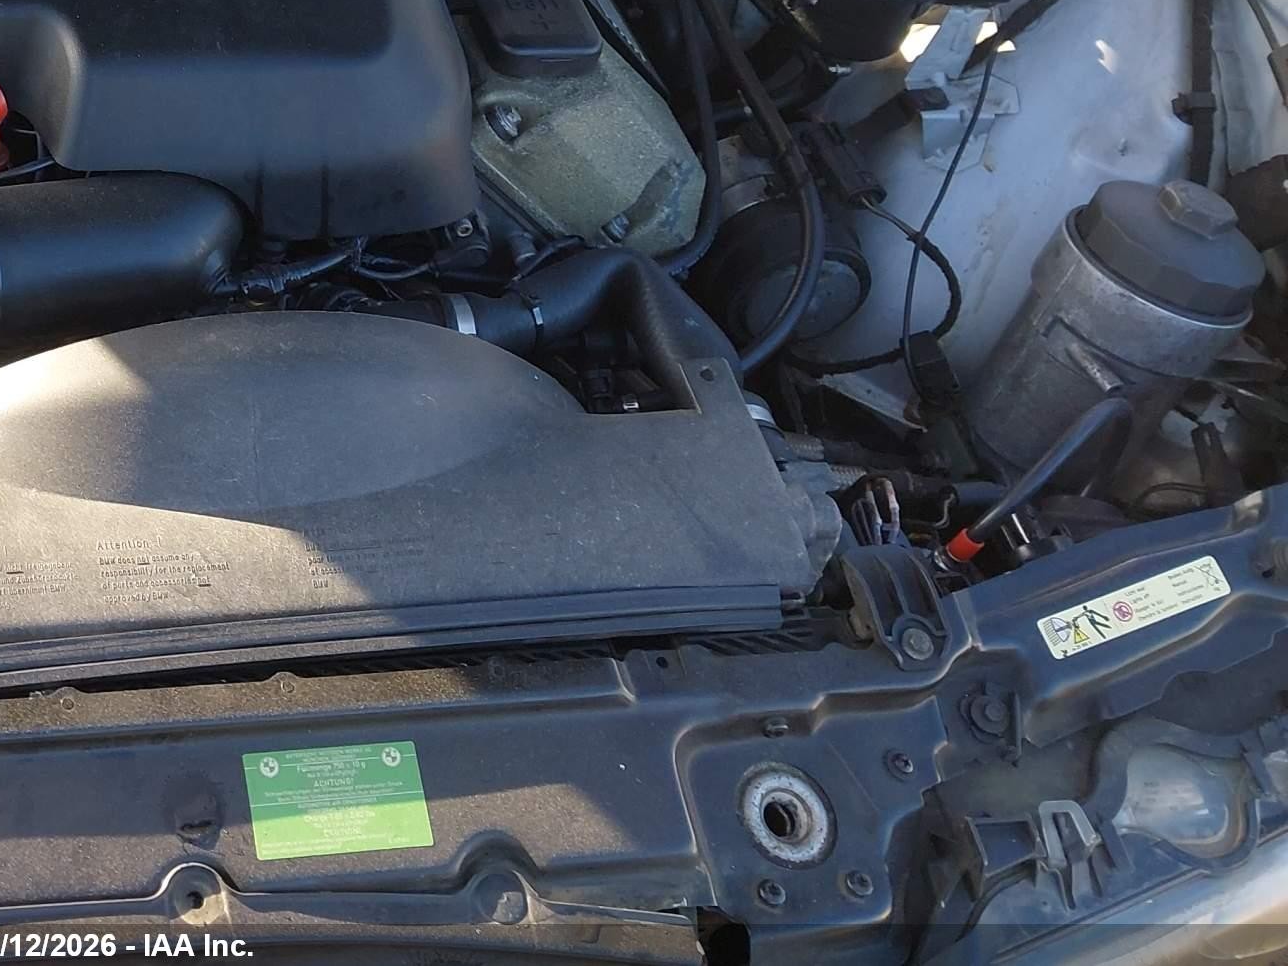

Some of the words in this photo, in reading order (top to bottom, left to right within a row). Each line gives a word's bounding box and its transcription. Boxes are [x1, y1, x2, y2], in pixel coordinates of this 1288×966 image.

[97, 538, 150, 551] Attention
[99, 557, 116, 566] BMW
[118, 556, 136, 565] does
[137, 554, 150, 564] not
[152, 554, 179, 563] assume
[181, 553, 194, 562] any
[101, 567, 153, 579] responsibility
[155, 565, 167, 574] for
[169, 564, 181, 574] the
[183, 561, 231, 575] replacement
[113, 580, 134, 591] parts
[135, 579, 149, 588] and
[151, 576, 196, 587] accessories
[197, 575, 211, 585] not
[104, 594, 140, 605] approved
[152, 591, 169, 601] BMW
